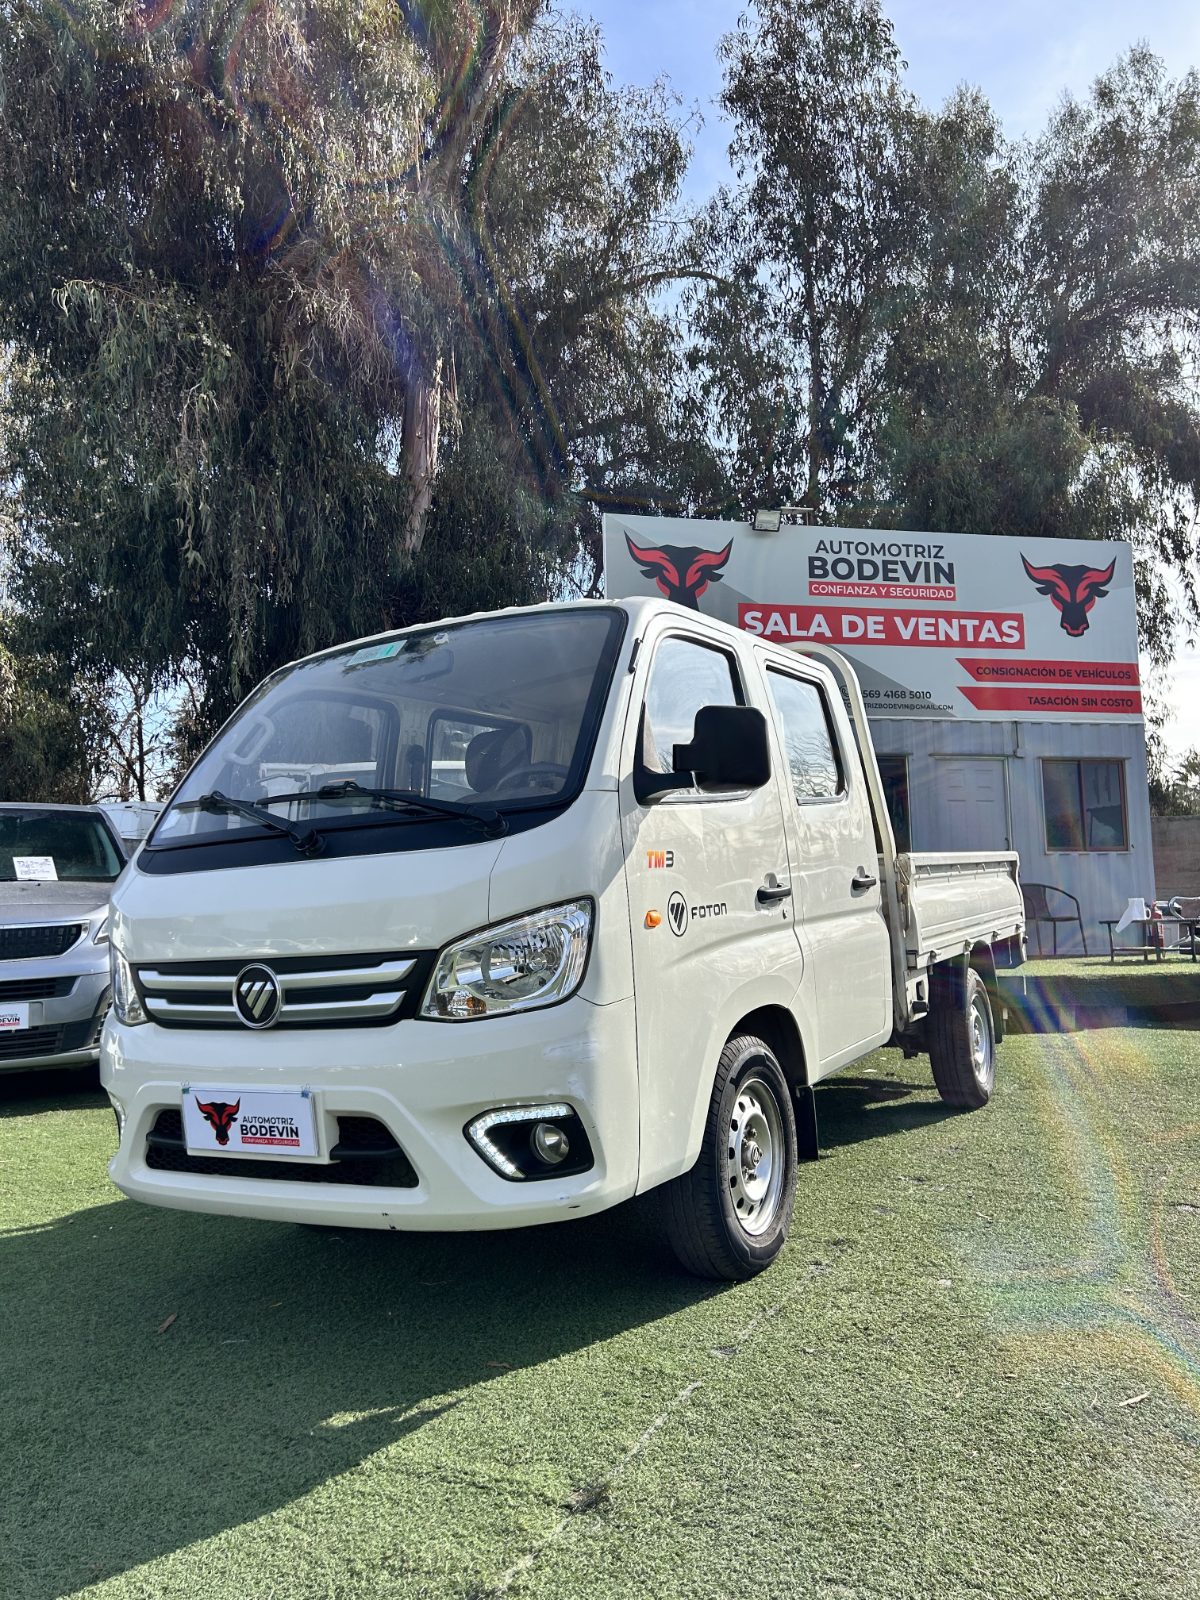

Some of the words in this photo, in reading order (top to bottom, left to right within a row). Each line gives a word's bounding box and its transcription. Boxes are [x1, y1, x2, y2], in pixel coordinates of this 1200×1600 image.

[815, 539, 945, 560] AUTOMOTRIZ
[808, 556, 955, 584] BODEVIN
[811, 584, 878, 596] CONFIANZA
[880, 586, 888, 596] Y
[889, 587, 954, 599] SEGURIDAD
[743, 610, 832, 638] SALA
[841, 614, 886, 639] DE
[893, 616, 1021, 644] VENTAS
[976, 666, 1056, 677] CONSIGNACIÓN
[1059, 668, 1073, 678] DE
[1075, 667, 1132, 680] VEHÍCULOS
[883, 690, 907, 700] 4168
[909, 691, 932, 700] 5010
[1028, 695, 1079, 707] TASACIÓN
[1080, 697, 1098, 707] SIN
[1100, 698, 1133, 708] COSTO
[646, 850, 674, 868] TM3
[691, 902, 728, 919] FOTON
[242, 1116, 294, 1125] AUTOMOTRIZ
[240, 1125, 299, 1138] BODEVIN
